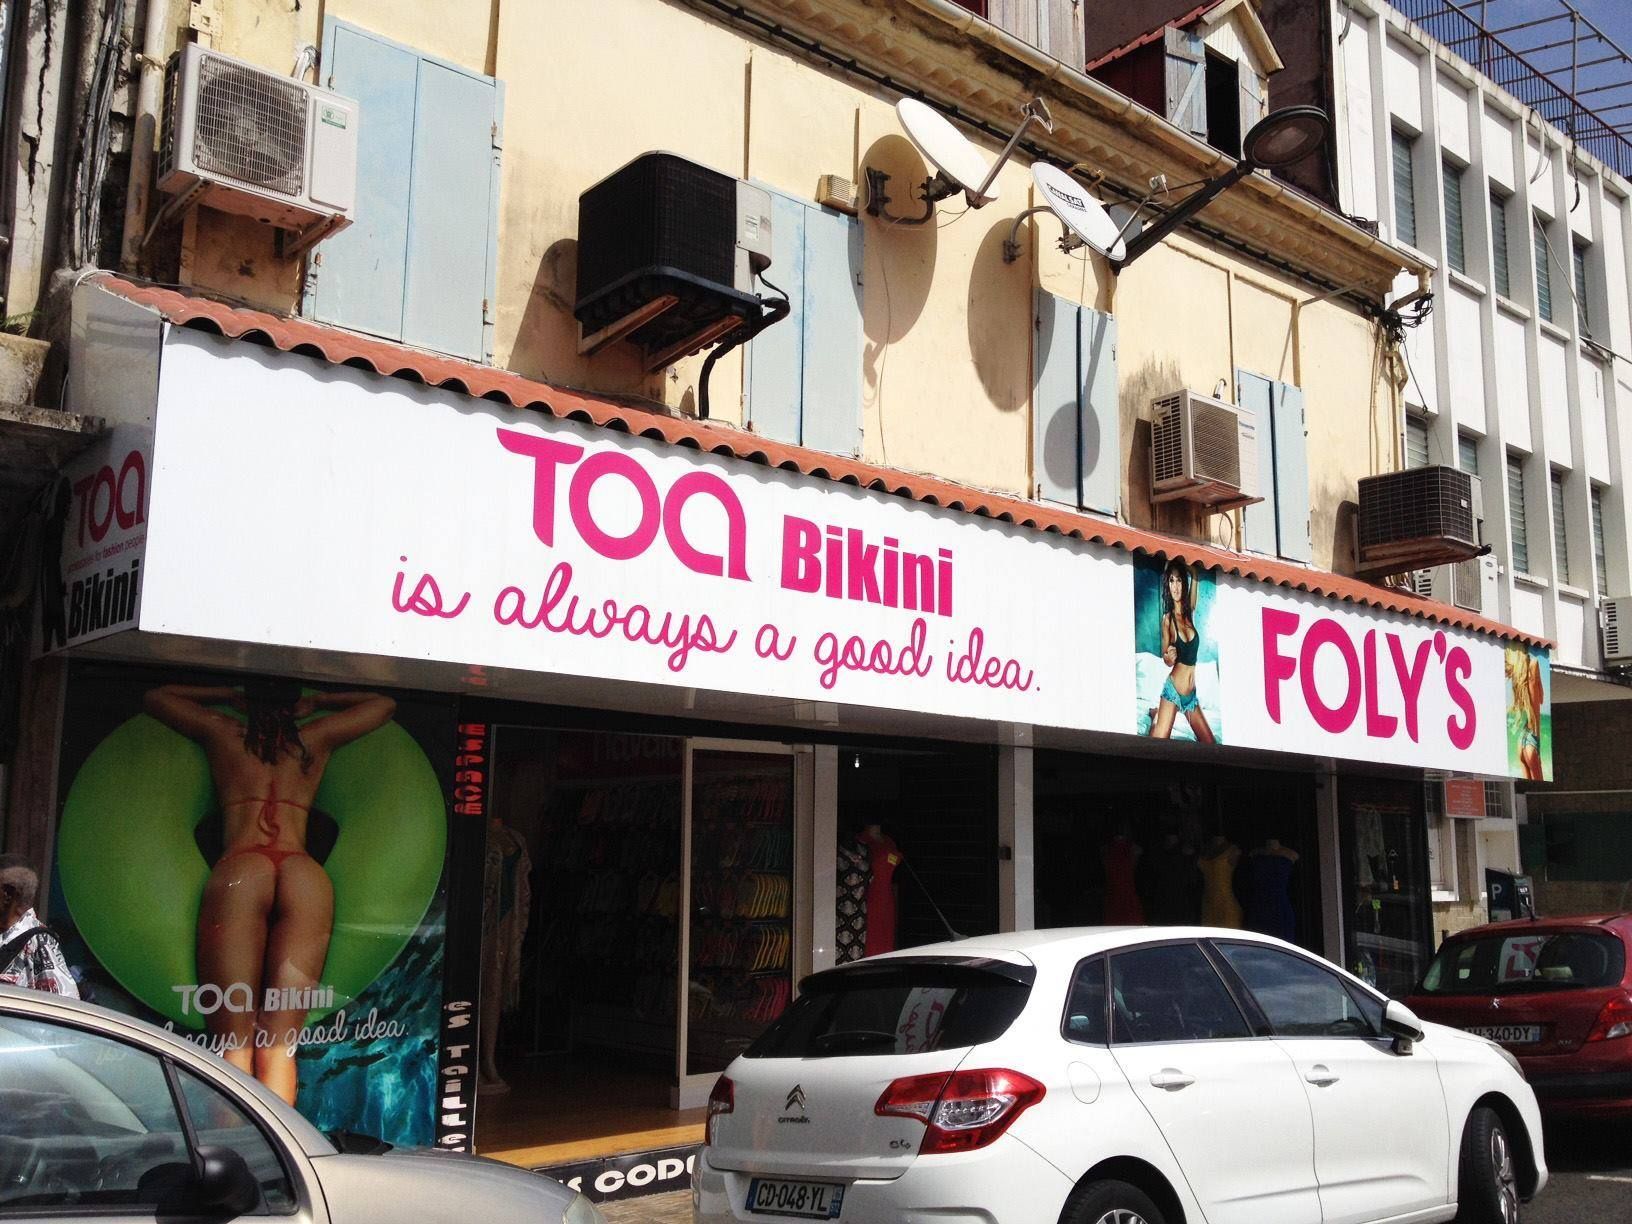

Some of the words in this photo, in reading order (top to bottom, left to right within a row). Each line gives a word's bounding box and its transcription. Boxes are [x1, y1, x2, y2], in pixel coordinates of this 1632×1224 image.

[67, 558, 140, 639] Bikini
[781, 515, 953, 617] Bikini
[391, 555, 470, 618] is
[494, 562, 737, 672] always
[756, 624, 796, 660] a
[815, 618, 932, 689] good
[946, 626, 1042, 692] idea.
[1262, 607, 1477, 750] FOLY'S
[256, 1031, 277, 1049] a
[284, 1009, 348, 1058] good
[354, 1007, 409, 1040] idea.
[264, 985, 334, 1012] Bikini
